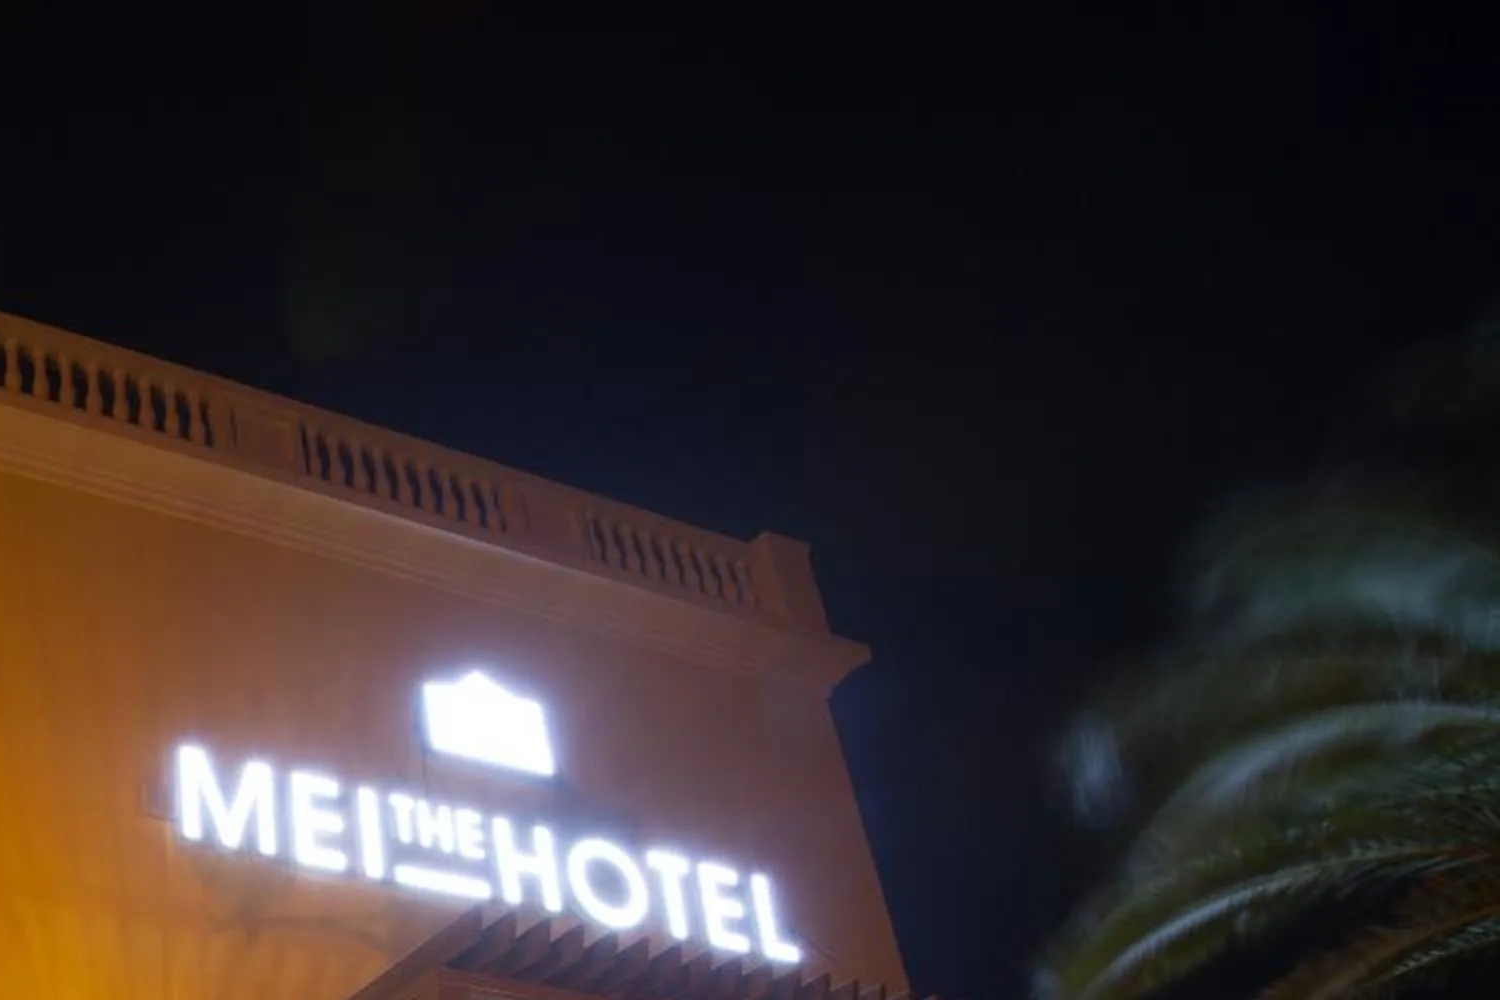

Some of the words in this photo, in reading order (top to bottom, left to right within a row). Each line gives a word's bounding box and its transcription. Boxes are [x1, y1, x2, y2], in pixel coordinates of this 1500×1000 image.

[176, 745, 385, 879] MEI
[388, 793, 486, 860] THE
[492, 816, 800, 963] HOTEL
